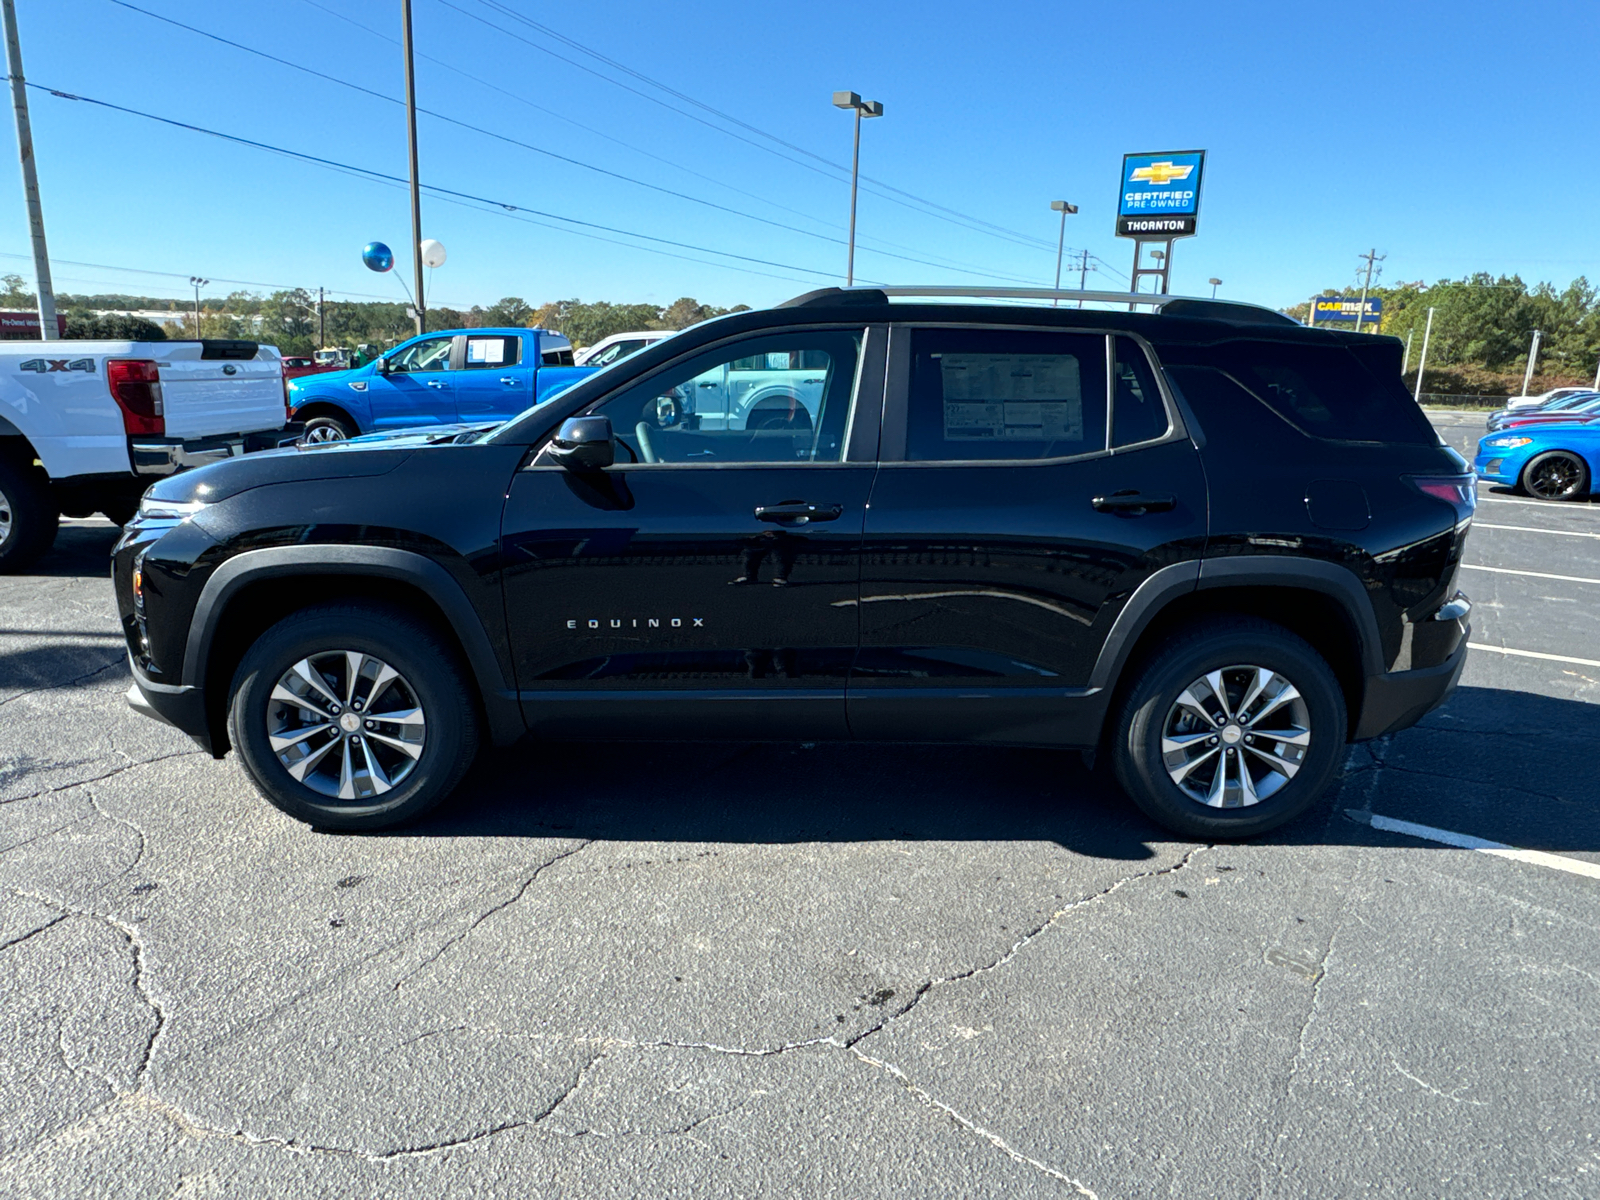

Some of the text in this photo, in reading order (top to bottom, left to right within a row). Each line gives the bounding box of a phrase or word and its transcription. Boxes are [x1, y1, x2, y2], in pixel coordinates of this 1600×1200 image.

[1125, 191, 1193, 201] CERTIFIED
[1127, 200, 1189, 208] PRE-OWNED
[1127, 221, 1185, 230] THORNTON
[566, 618, 704, 629] EQUINOX
